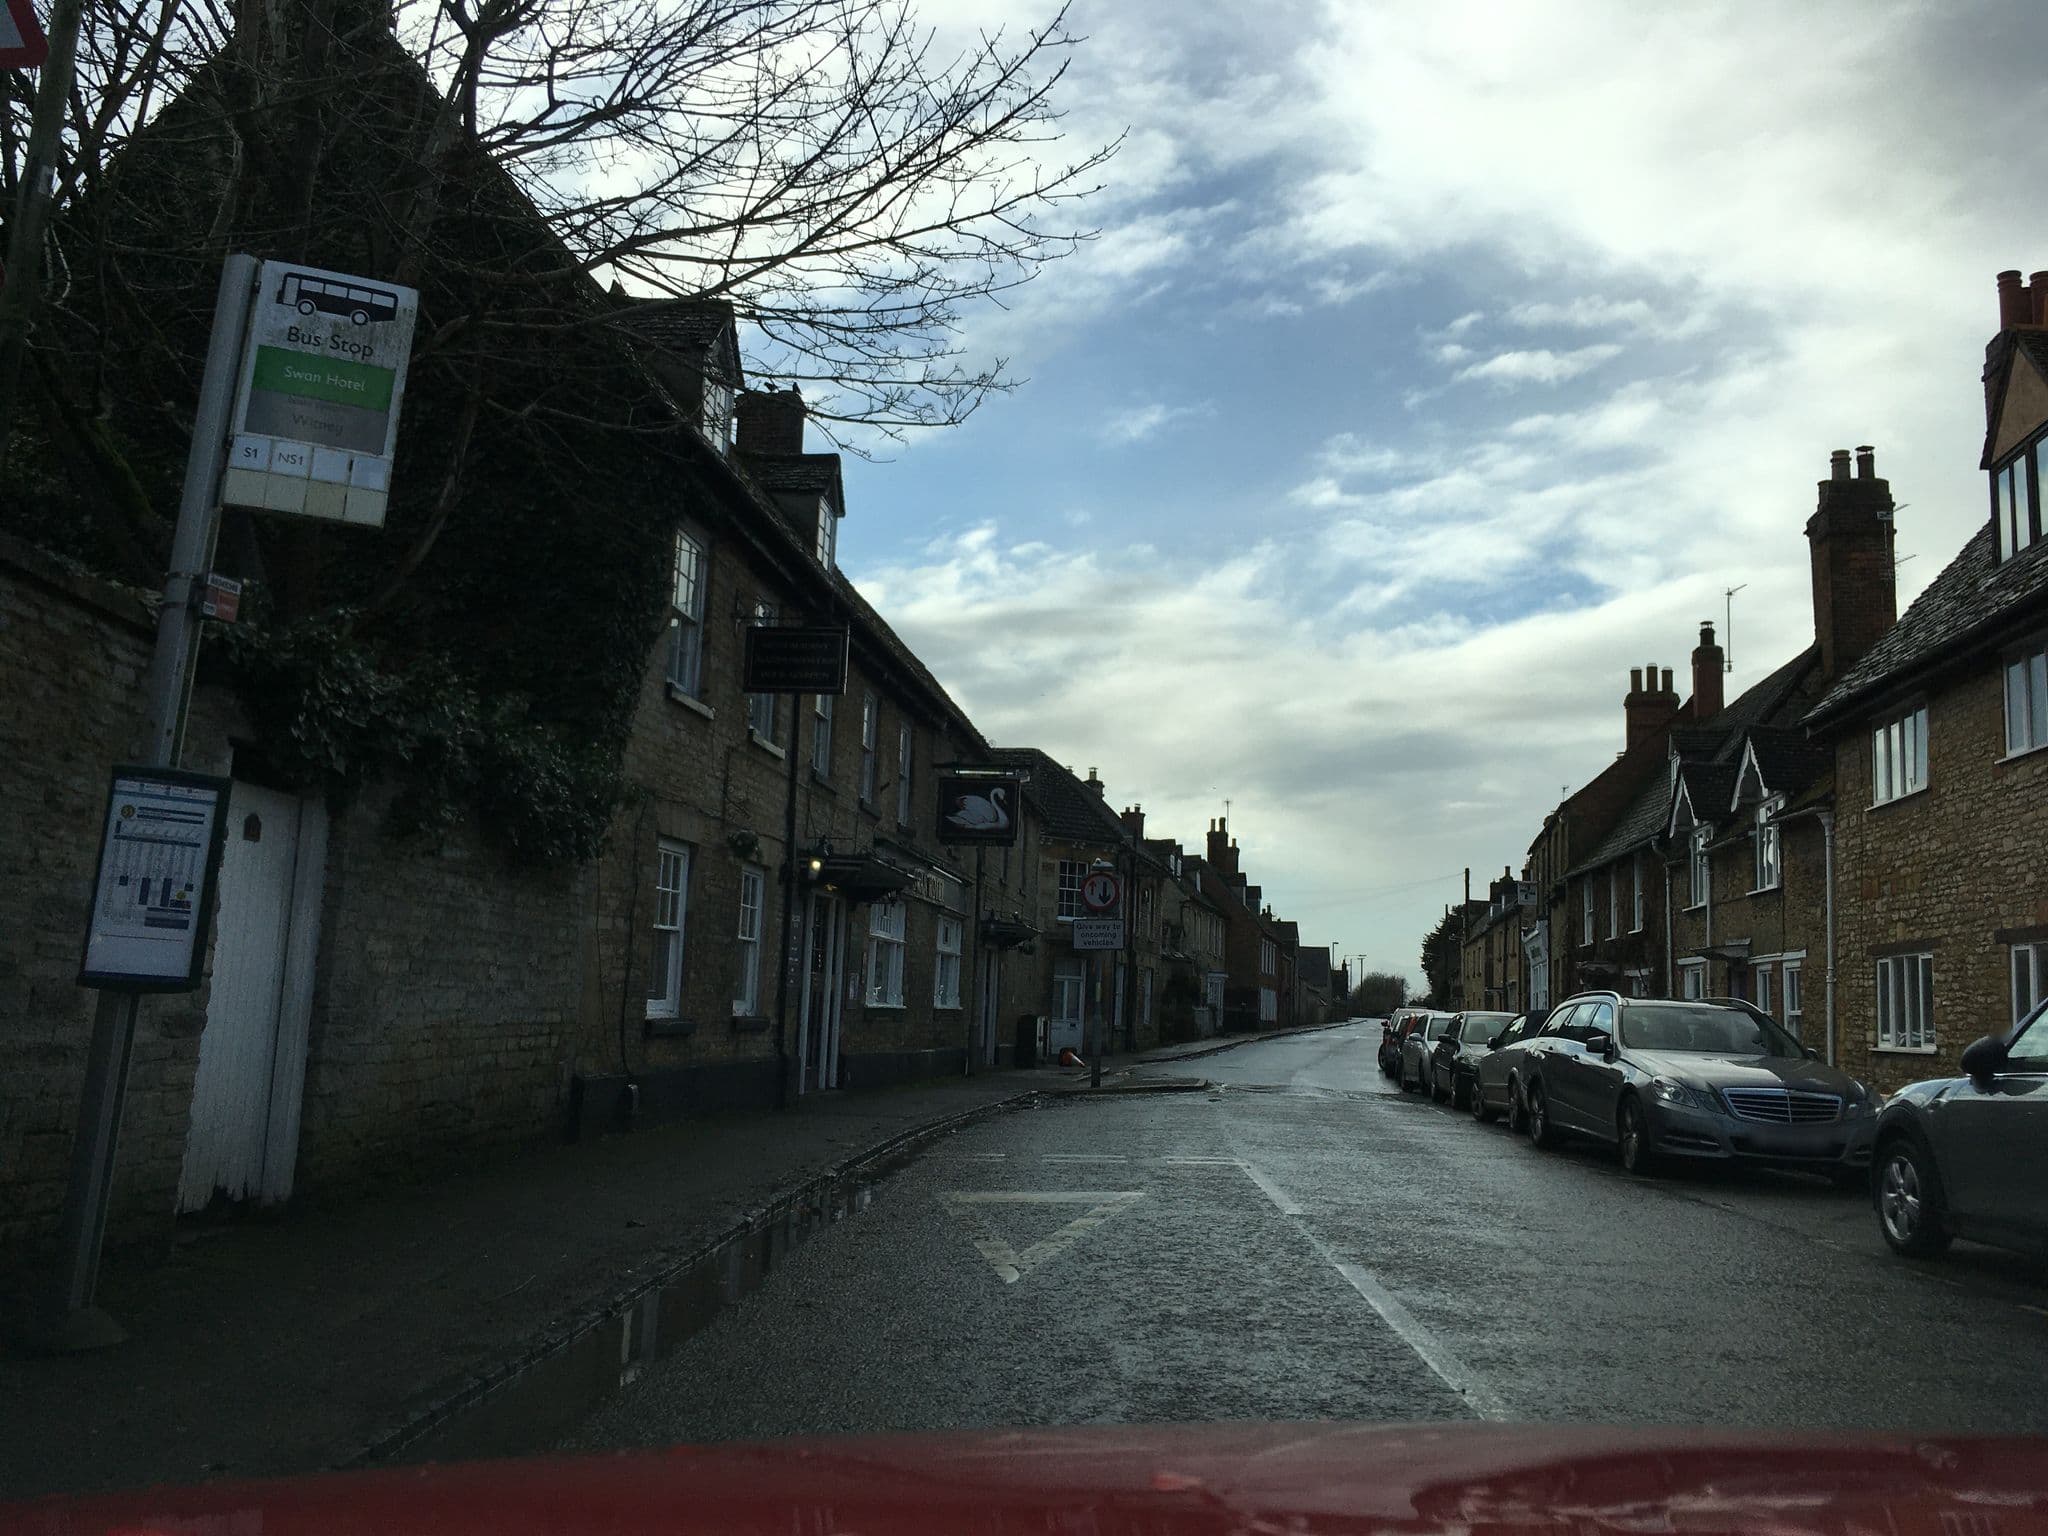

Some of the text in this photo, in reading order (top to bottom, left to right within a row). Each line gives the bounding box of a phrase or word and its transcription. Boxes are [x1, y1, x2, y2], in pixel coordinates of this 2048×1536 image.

[287, 325, 374, 360] Bus Stop
[284, 366, 366, 391] Swan Hotel
[243, 447, 304, 466] S1 NS1
